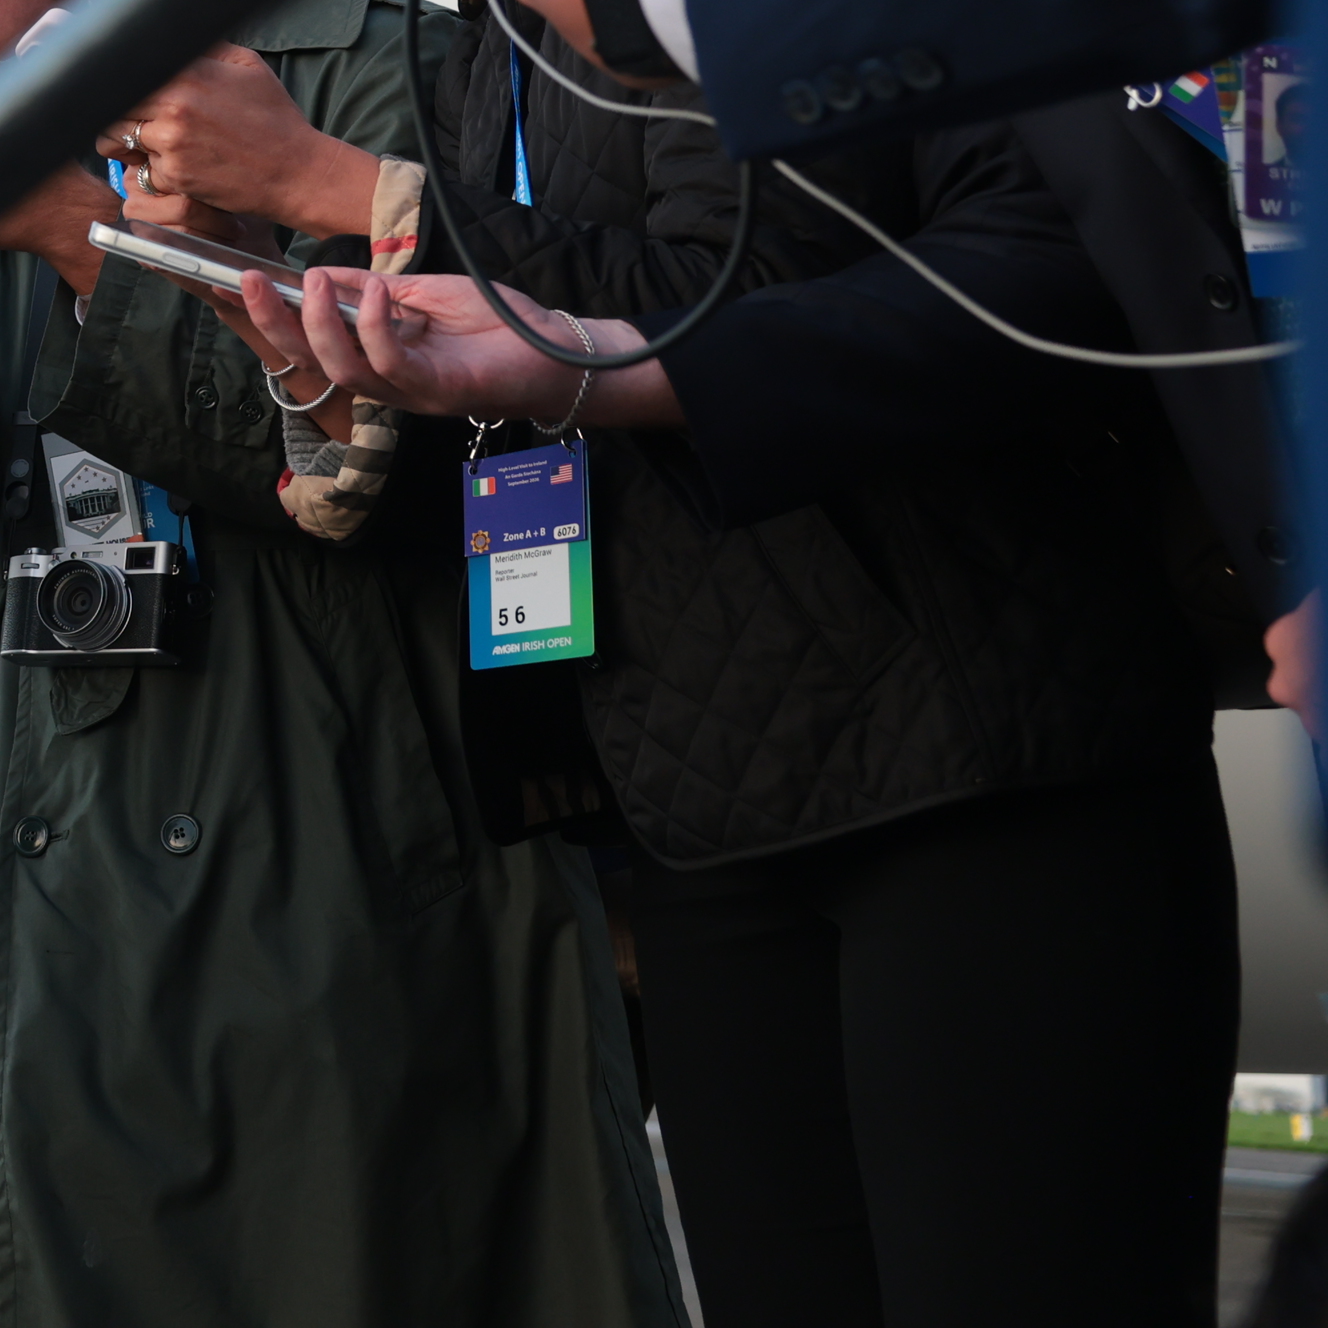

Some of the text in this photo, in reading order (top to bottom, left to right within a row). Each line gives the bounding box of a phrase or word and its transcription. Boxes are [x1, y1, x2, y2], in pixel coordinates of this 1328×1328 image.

[503, 532, 524, 542] Zone
[525, 529, 532, 539] A
[540, 527, 546, 536] B
[557, 526, 577, 537] 6076
[495, 549, 552, 563] Meridith McGraw
[521, 571, 538, 579] Journal
[499, 606, 525, 626] 5 6
[492, 636, 572, 656] AMGEN IRISH OPEN
